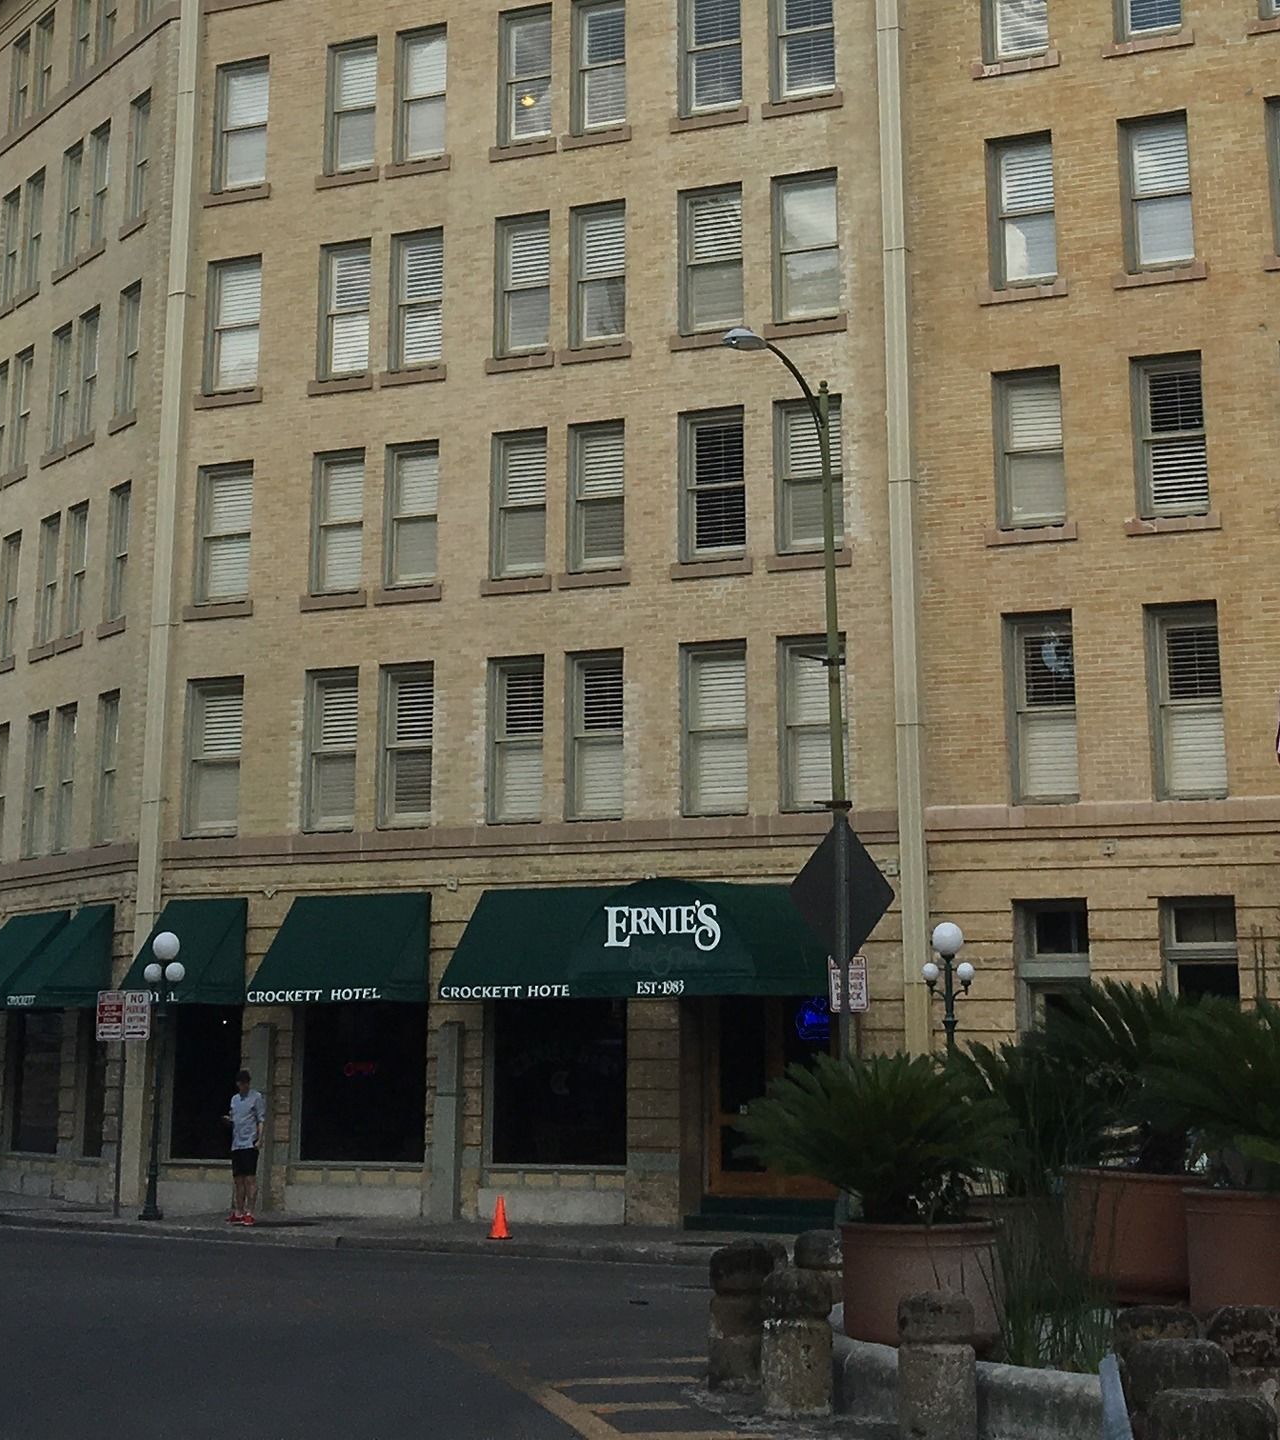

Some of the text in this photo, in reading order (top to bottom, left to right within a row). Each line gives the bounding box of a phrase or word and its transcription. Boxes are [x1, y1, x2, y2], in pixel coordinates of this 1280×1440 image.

[603, 899, 721, 951] ERNIE'S
[130, 994, 144, 1004] NO
[246, 987, 381, 1003] CROCKETT HOTEL
[440, 984, 571, 999] CROCKETT HOTE
